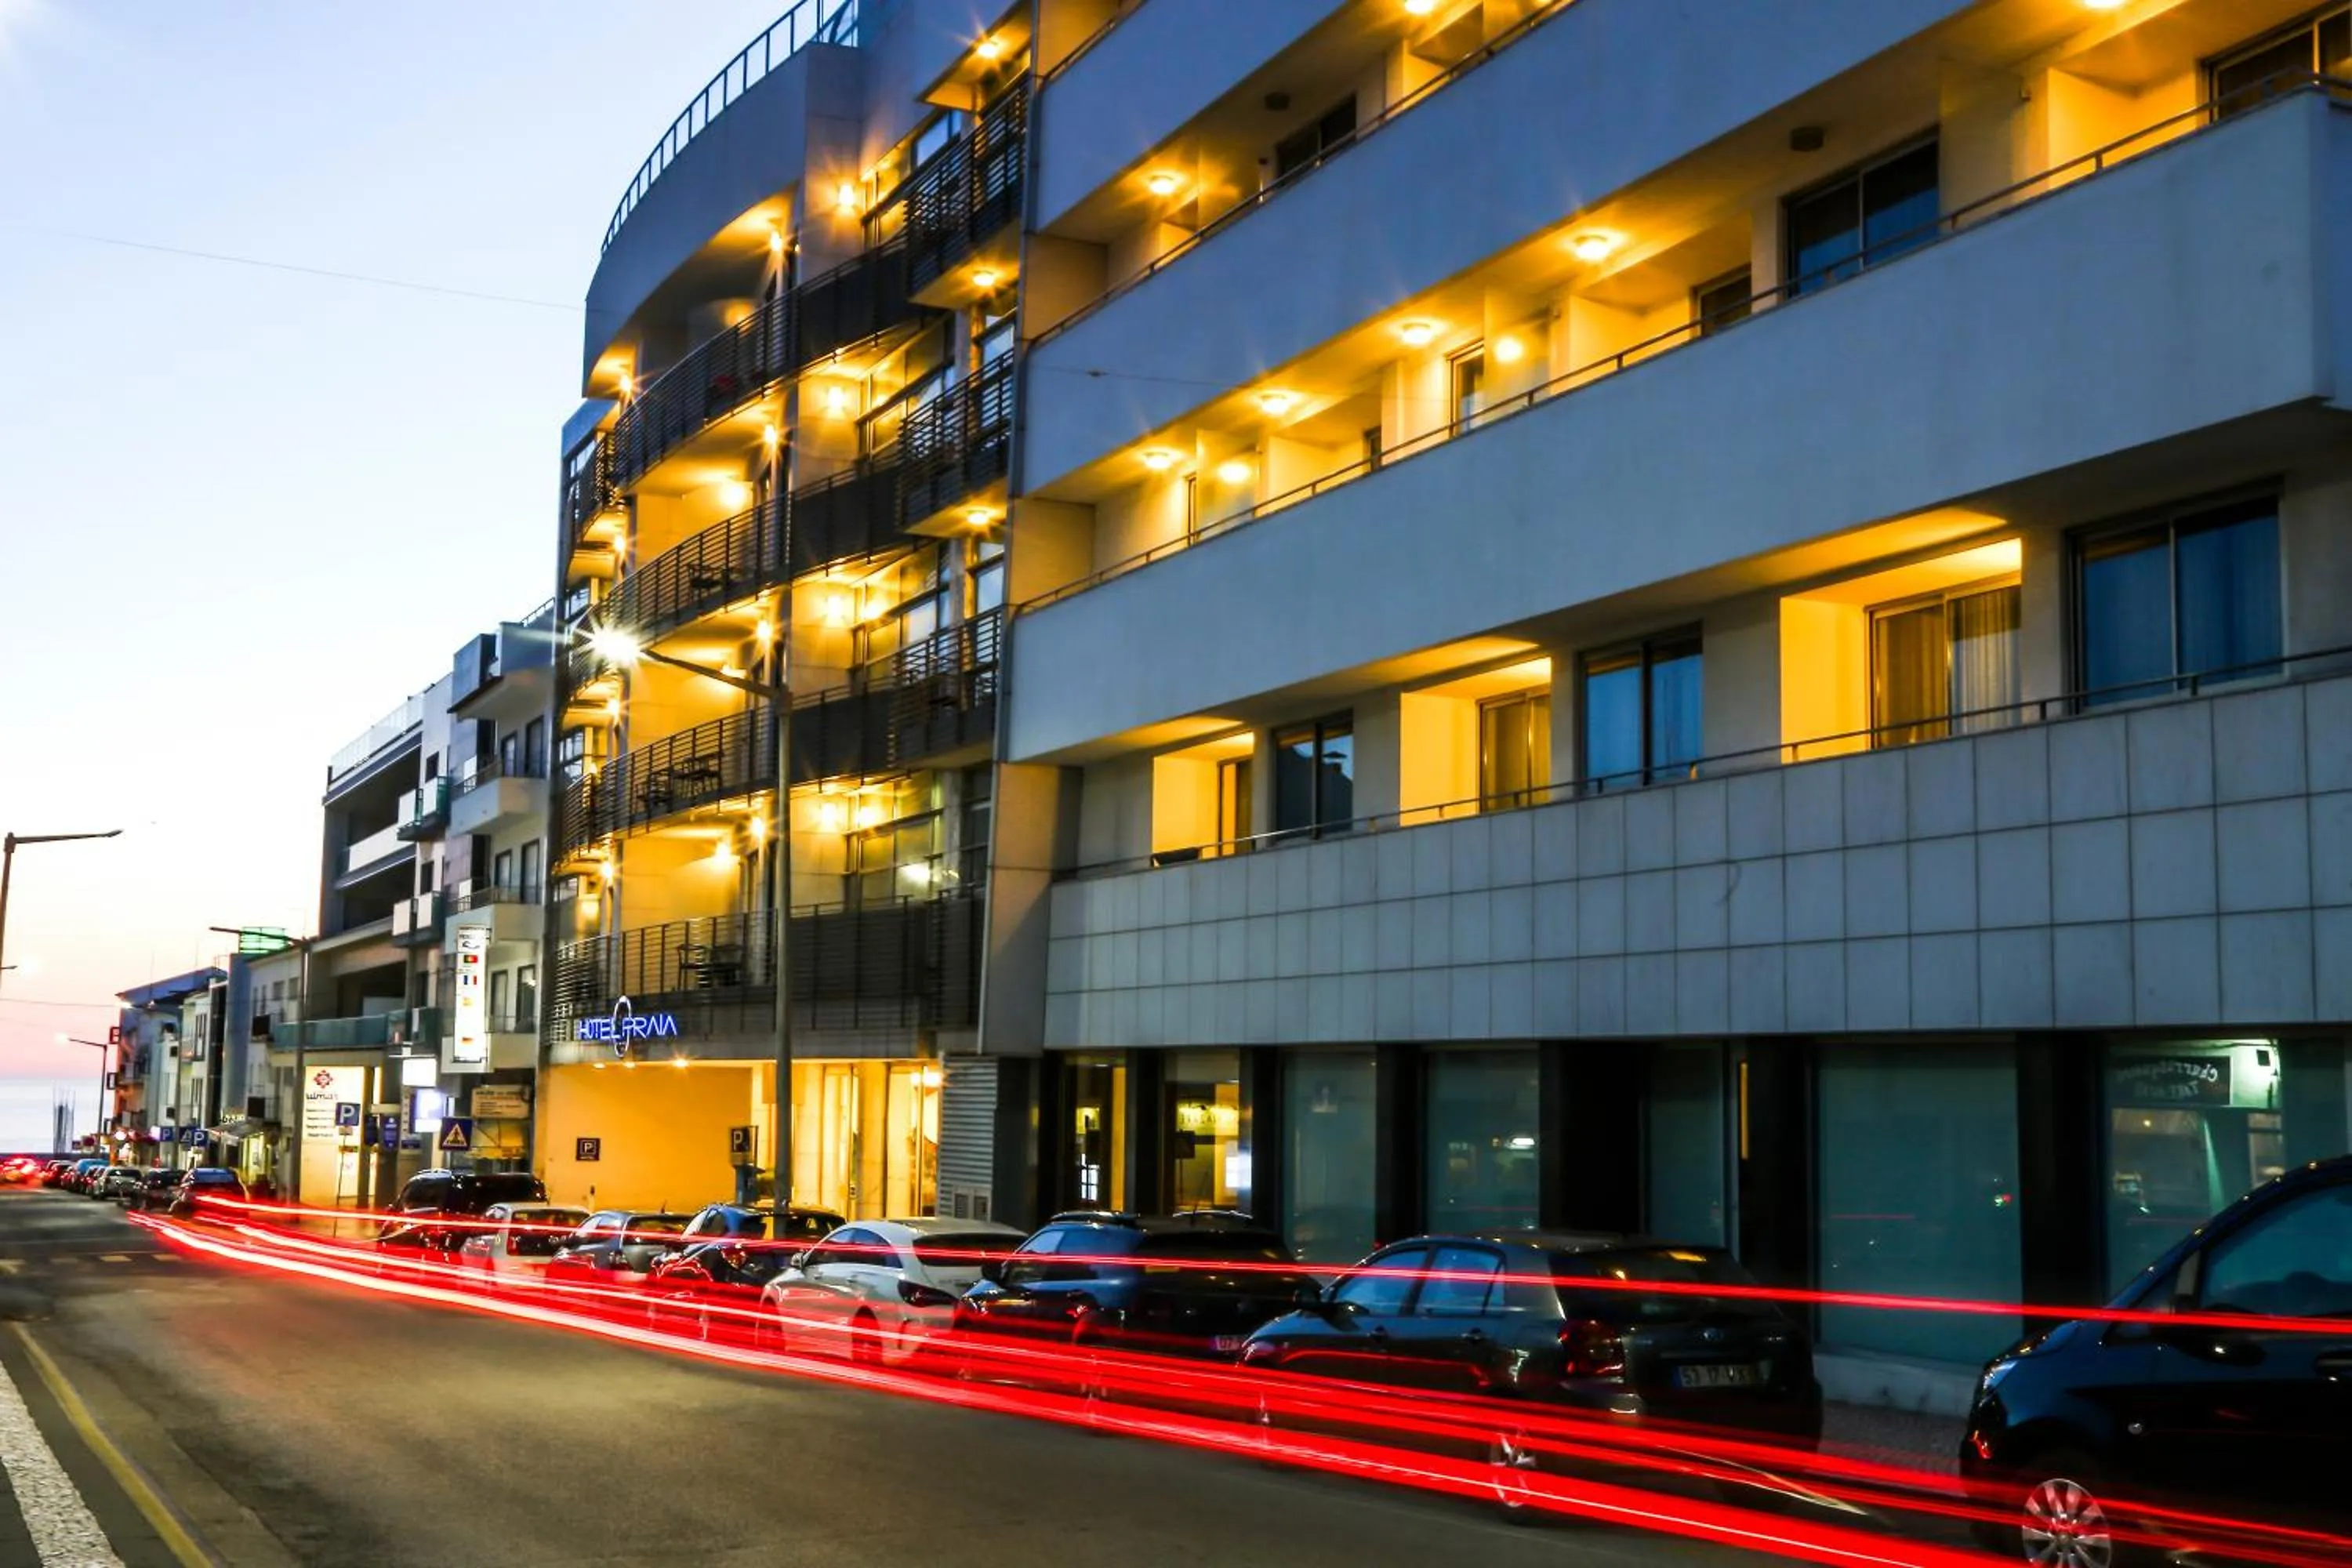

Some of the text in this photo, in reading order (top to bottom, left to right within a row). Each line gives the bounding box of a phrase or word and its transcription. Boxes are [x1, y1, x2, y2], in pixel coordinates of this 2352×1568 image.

[579, 1013, 678, 1040] HOTEL PRAIA
[339, 1104, 356, 1124] P
[162, 1129, 171, 1140] P
[194, 1131, 205, 1145] P
[733, 1131, 744, 1152] P
[584, 1142, 593, 1153] P
